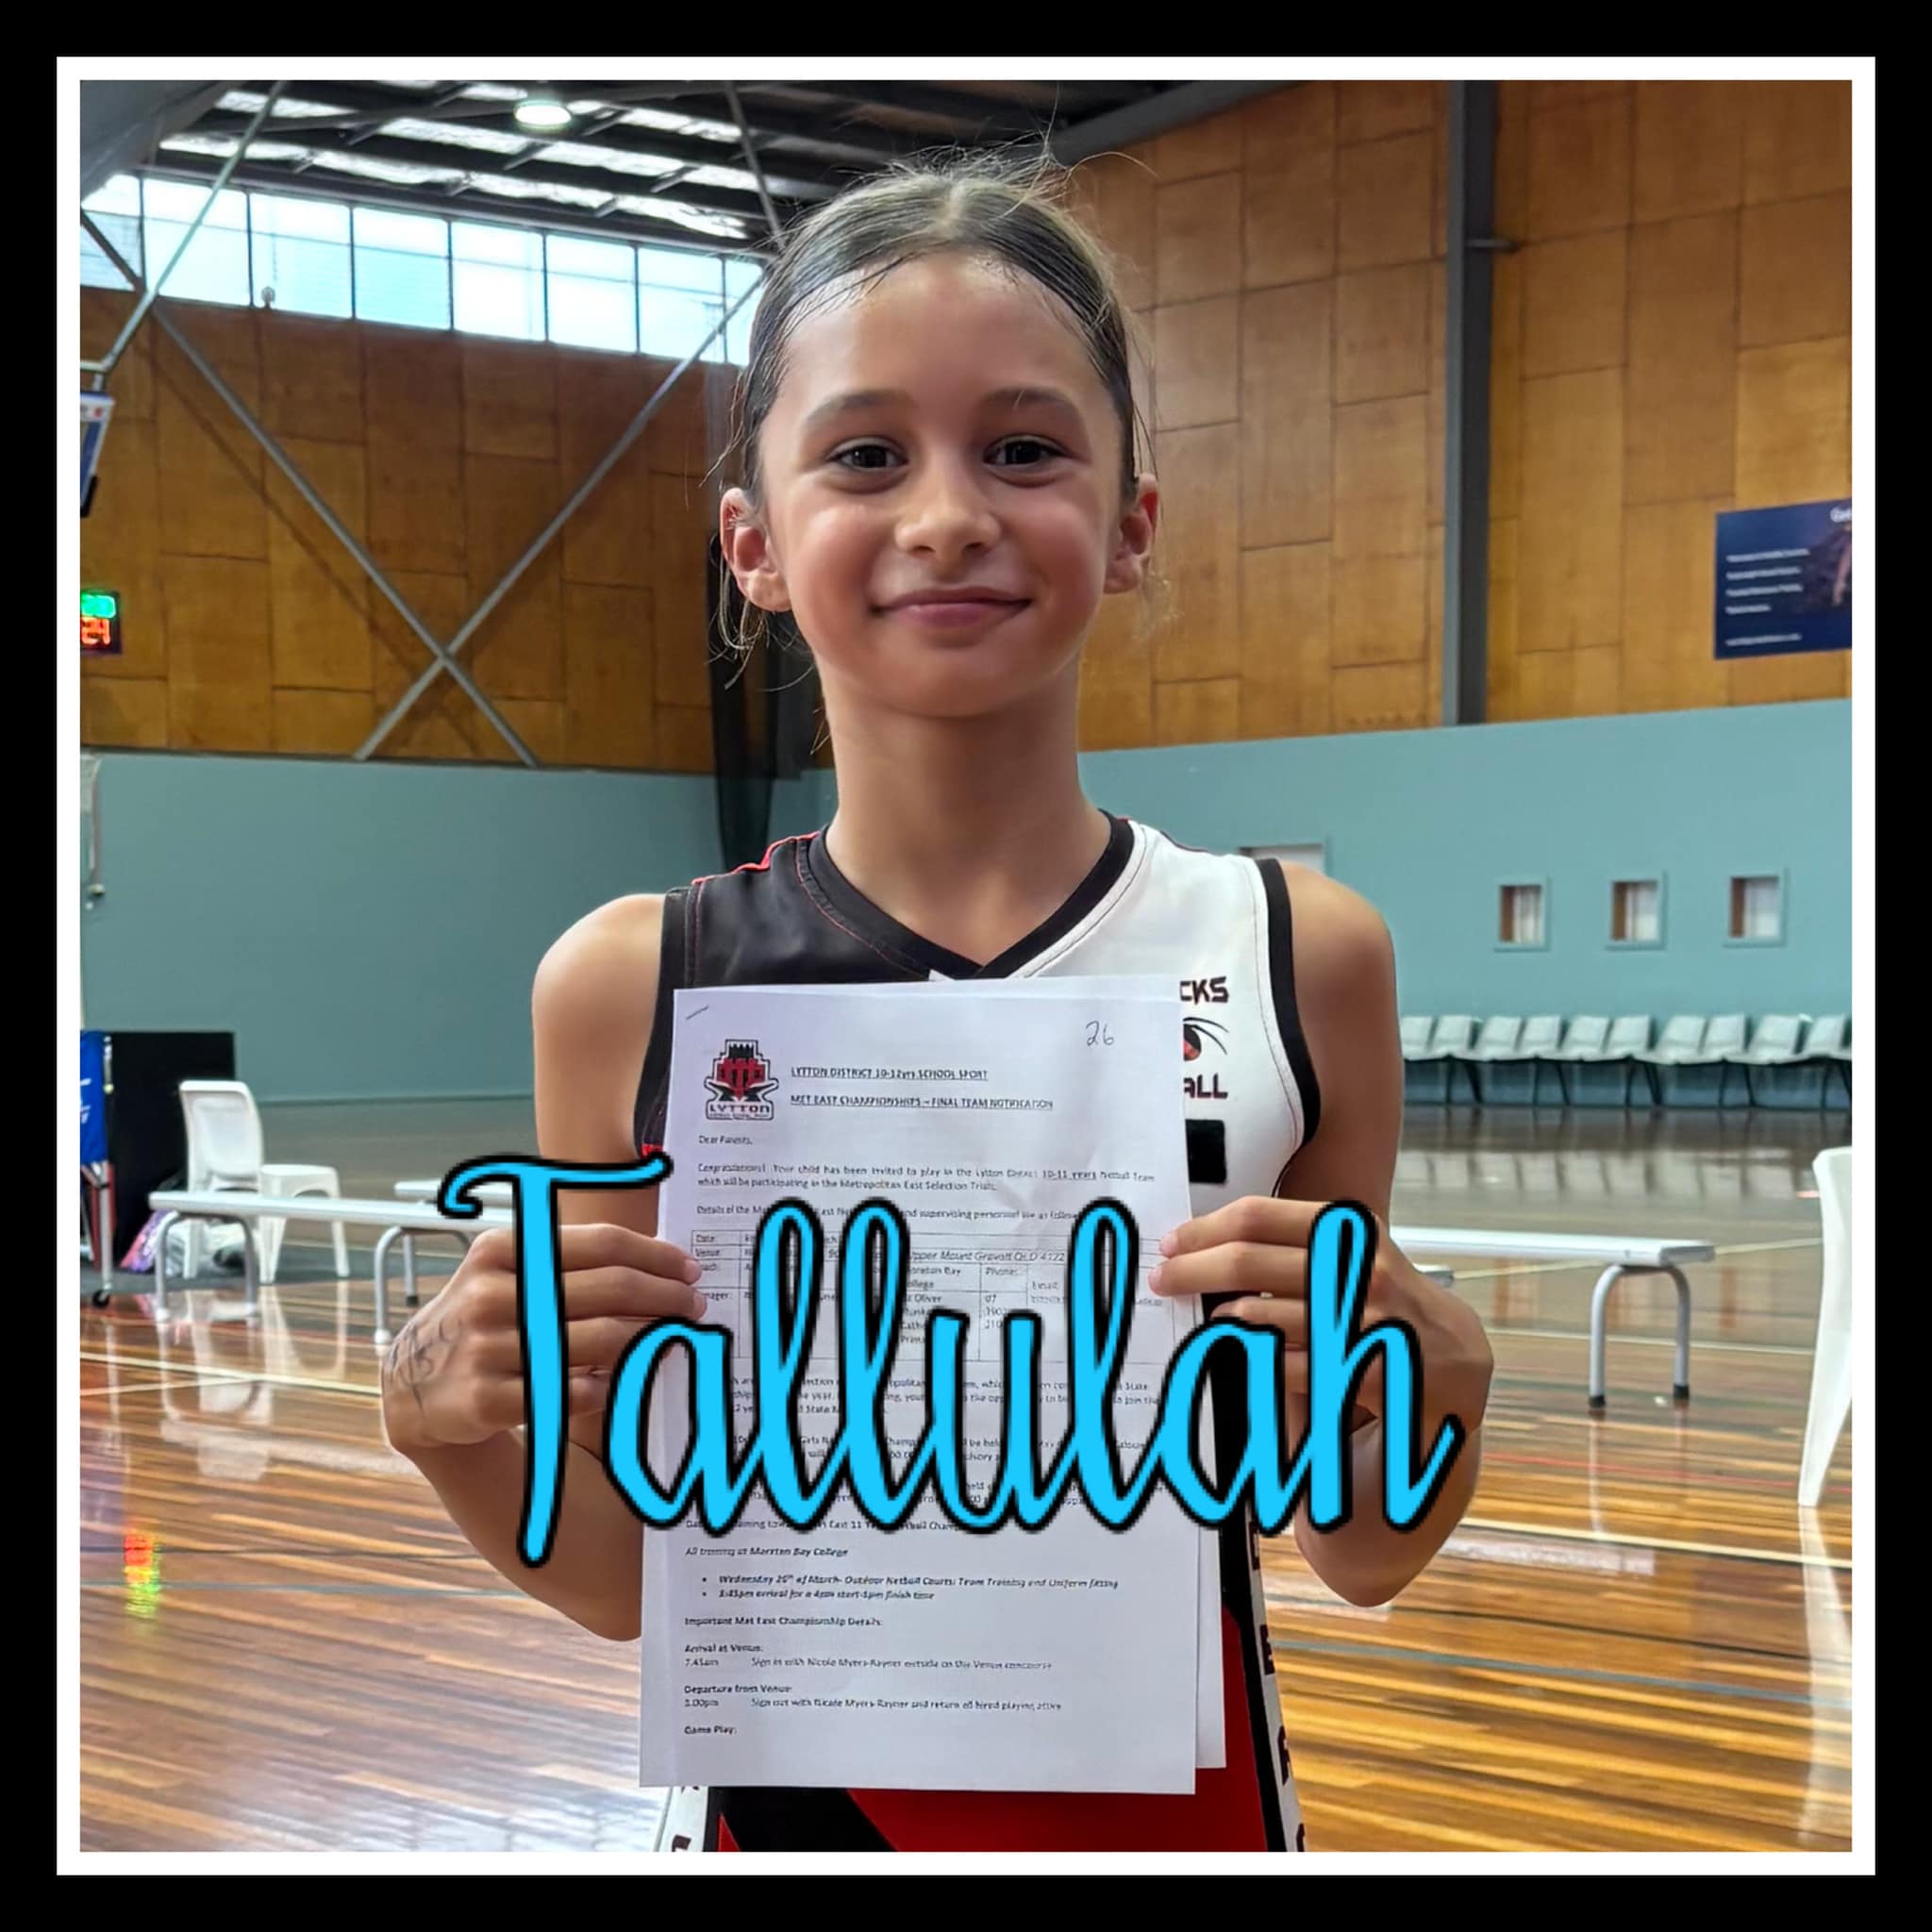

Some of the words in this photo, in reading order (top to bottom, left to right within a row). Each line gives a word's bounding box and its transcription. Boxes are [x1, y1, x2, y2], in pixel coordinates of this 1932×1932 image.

[1085, 1021, 1115, 1045] 26
[791, 1067, 827, 1078] LYTTON
[830, 1067, 873, 1079] DISTRICT
[918, 1069, 956, 1080] SCHOOL
[958, 1070, 989, 1081] SPORT
[791, 1094, 811, 1106] MET
[814, 1094, 838, 1106] EAST
[840, 1095, 922, 1108] CHAMPIONSHIPS
[931, 1097, 958, 1108] FINAL
[960, 1098, 989, 1109] TEAM
[991, 1099, 1054, 1111] NOTIFICATION
[698, 1135, 719, 1145] Dear
[773, 1164, 793, 1174] Your
[798, 1164, 821, 1174] child
[824, 1165, 841, 1174] has
[844, 1165, 867, 1175] been
[872, 1166, 903, 1176] invited
[907, 1167, 917, 1176] to
[921, 1166, 940, 1177] play
[957, 1167, 972, 1177] the
[697, 1177, 722, 1187] which
[740, 1177, 751, 1187] be
[751, 1178, 808, 1190] participating
[823, 1178, 838, 1188] the
[840, 1179, 901, 1190] Metropolitan
[904, 1180, 924, 1190] East
[925, 1181, 968, 1191] Selection
[696, 1206, 725, 1215] Details
[736, 1206, 750, 1215] the
[919, 1208, 972, 1220] supervising
[974, 1209, 1020, 1221] personnel
[908, 1250, 937, 1262] pper
[941, 1250, 973, 1261] Mount
[974, 1251, 1011, 1261] Gravatt
[943, 1267, 961, 1277] Bay
[907, 1280, 935, 1291] ollege
[685, 1547, 698, 1557] All
[700, 1547, 736, 1557] training
[792, 1547, 811, 1557] Bay
[813, 1547, 849, 1557] College
[719, 1574, 774, 1586] Wednesday
[844, 1574, 885, 1586] Outdoor
[958, 1576, 985, 1587] Team
[988, 1577, 1026, 1589] Training
[1027, 1578, 1046, 1588] and
[1048, 1578, 1087, 1590] Uniform
[755, 1589, 788, 1598] arrival
[789, 1589, 803, 1600] for
[685, 1616, 733, 1627] Important
[734, 1616, 755, 1625] Met
[757, 1616, 776, 1625] East
[777, 1616, 847, 1627] Championship
[685, 1643, 717, 1653] Arrival
[751, 1657, 772, 1668] Sign
[785, 1657, 806, 1667] with
[807, 1657, 837, 1667] Nicole
[684, 1685, 733, 1695] Departure
[735, 1684, 758, 1694] from
[751, 1698, 772, 1708] Sign
[791, 1698, 812, 1708] with
[813, 1698, 843, 1708] Nicole
[910, 1699, 929, 1708] and
[684, 1725, 712, 1735] Game
